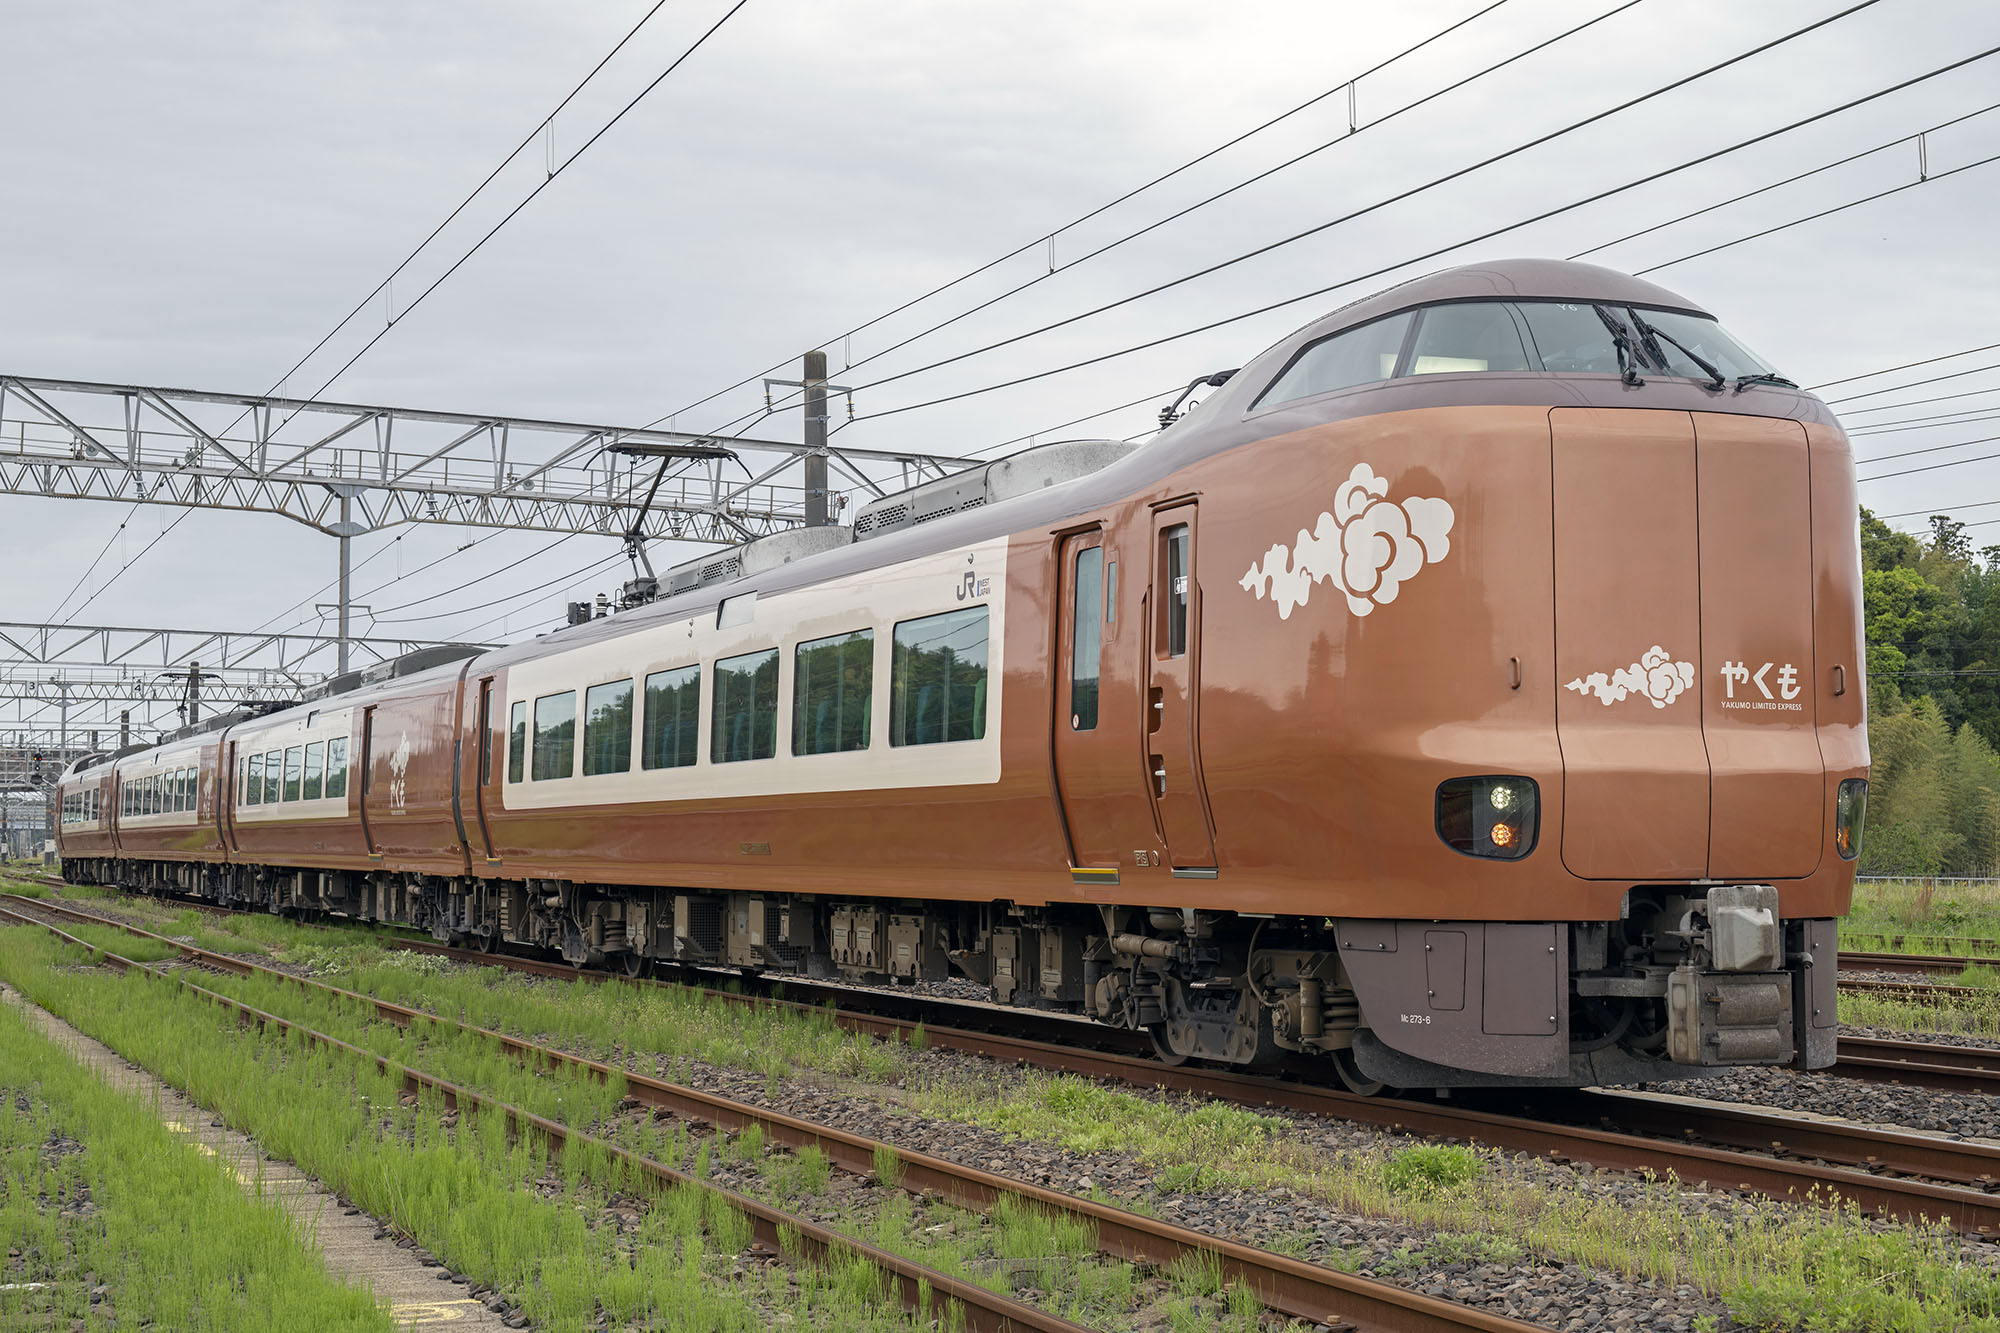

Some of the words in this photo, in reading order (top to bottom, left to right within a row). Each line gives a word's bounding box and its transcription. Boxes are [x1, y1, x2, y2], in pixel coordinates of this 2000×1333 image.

[956, 571, 976, 601] JR
[1720, 660, 1802, 700] やくも
[29, 682, 36, 690] 3
[1720, 701, 1751, 710] YAKUMO
[1752, 702, 1777, 710] LIMITED
[1777, 702, 1802, 711] EXPRESS
[1409, 1015, 1431, 1025] 273-6
